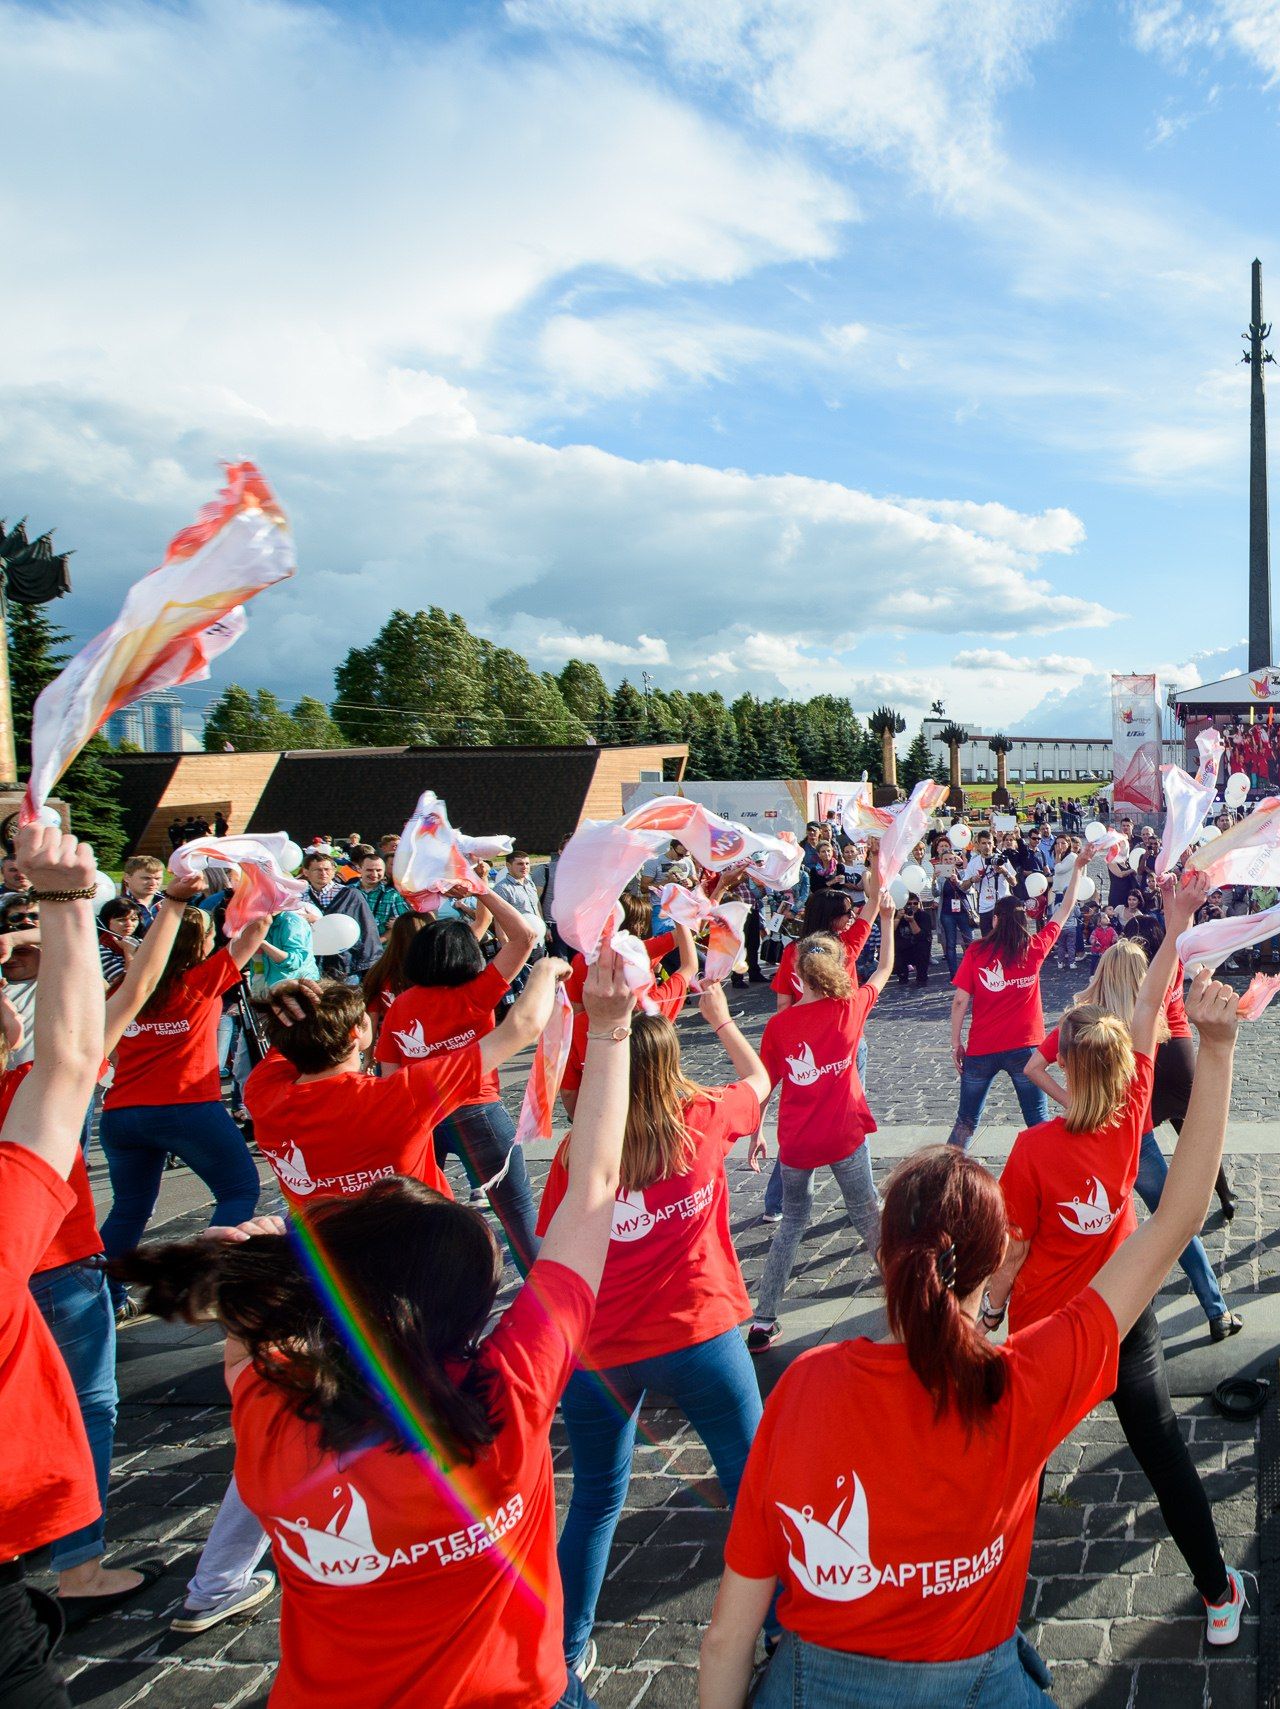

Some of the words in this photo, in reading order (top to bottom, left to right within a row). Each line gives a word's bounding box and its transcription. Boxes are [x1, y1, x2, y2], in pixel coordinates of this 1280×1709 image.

[140, 1019, 190, 1032] АРТЕРИЯ
[409, 1045, 428, 1055] МУЗ
[429, 1029, 476, 1052] АРТЕРИЯ
[797, 1068, 818, 1080] МУЗ
[317, 1165, 396, 1188] АРТЕРИЯ
[616, 1213, 652, 1236] МУЗ
[1084, 1213, 1113, 1231] МУЗ
[320, 1555, 380, 1577] МУЗ
[390, 1492, 524, 1569] АРТЕРИЯ
[440, 1505, 524, 1567] РОУДШОУ
[816, 1564, 872, 1586] МУЗ
[880, 1533, 1005, 1588] АРТЕРИЯ
[922, 1550, 1004, 1599] РОУДШОУ
